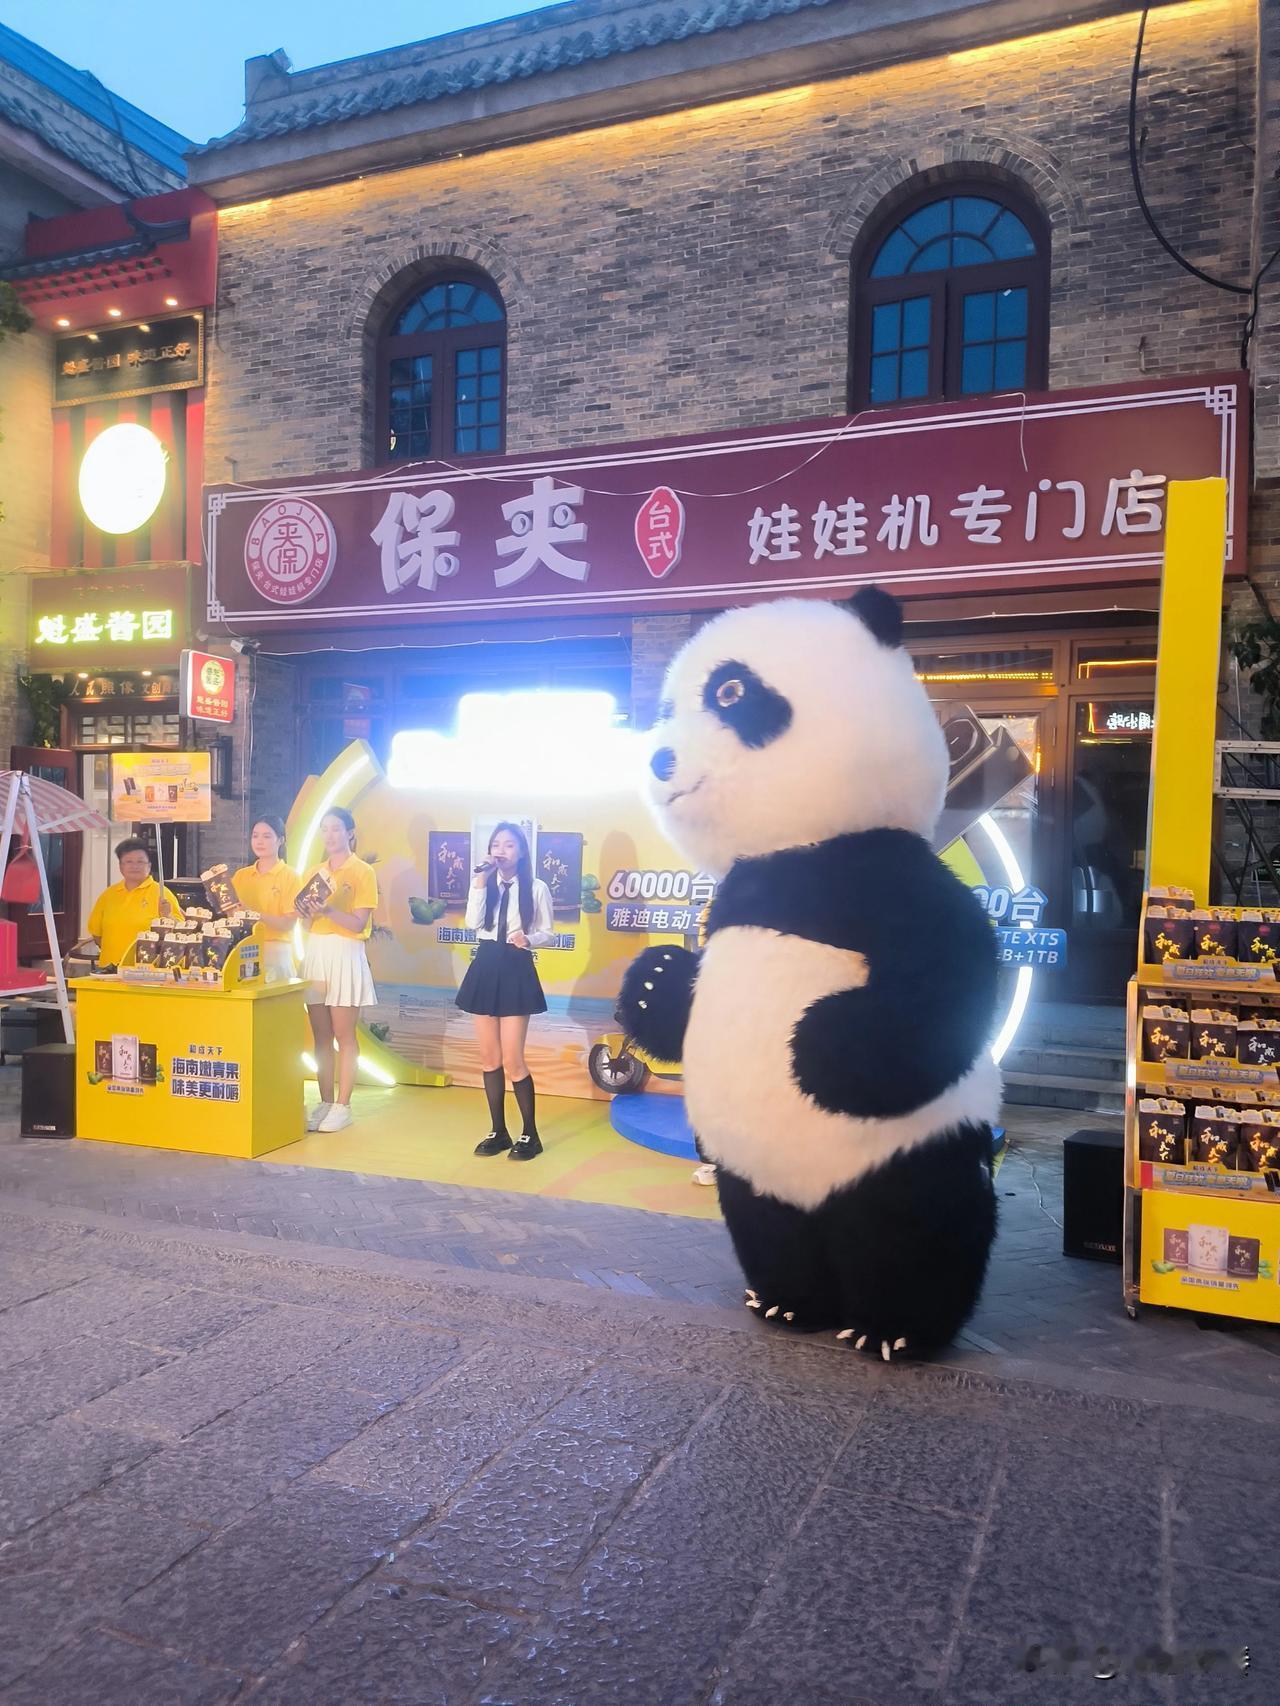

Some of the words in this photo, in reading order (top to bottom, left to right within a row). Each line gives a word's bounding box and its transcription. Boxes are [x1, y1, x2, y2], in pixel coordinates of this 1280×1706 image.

[251, 505, 325, 546] BAOJIA
[371, 476, 590, 594] 保夹
[644, 501, 677, 560] 台式
[747, 469, 1166, 565] 娃娃机专门店
[35, 610, 173, 645] 魁盛酱园
[608, 871, 718, 900] 60000台
[997, 948, 1060, 965] B+1TB
